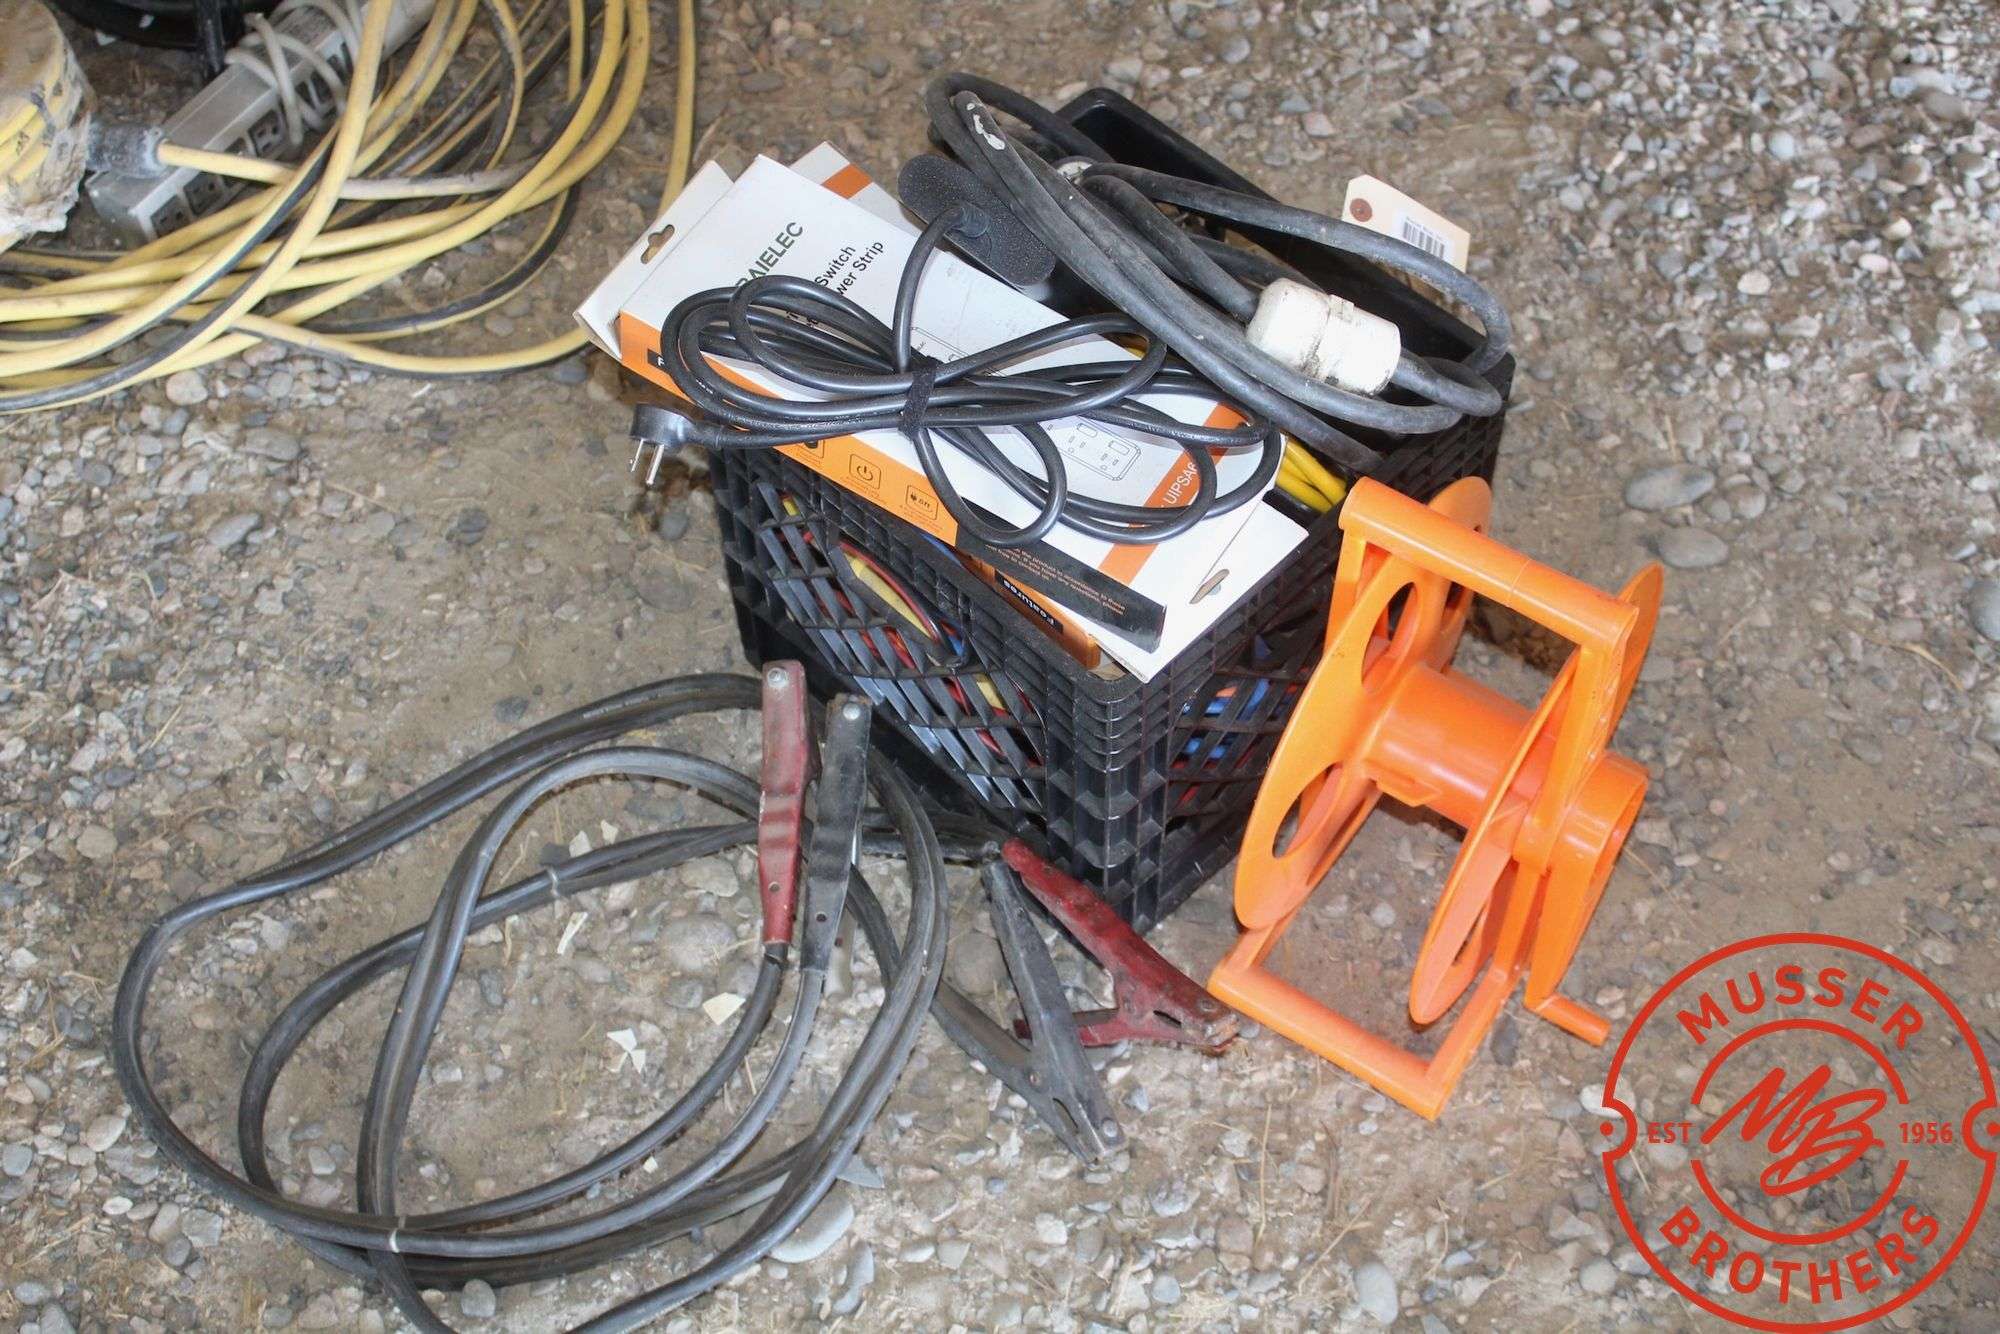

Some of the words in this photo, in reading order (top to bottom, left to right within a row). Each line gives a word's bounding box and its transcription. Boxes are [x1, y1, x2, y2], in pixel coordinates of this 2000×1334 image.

[815, 245, 856, 287] Switch
[836, 265, 858, 296] wer
[853, 240, 884, 272] Strip
[1003, 579, 1055, 625] Features
